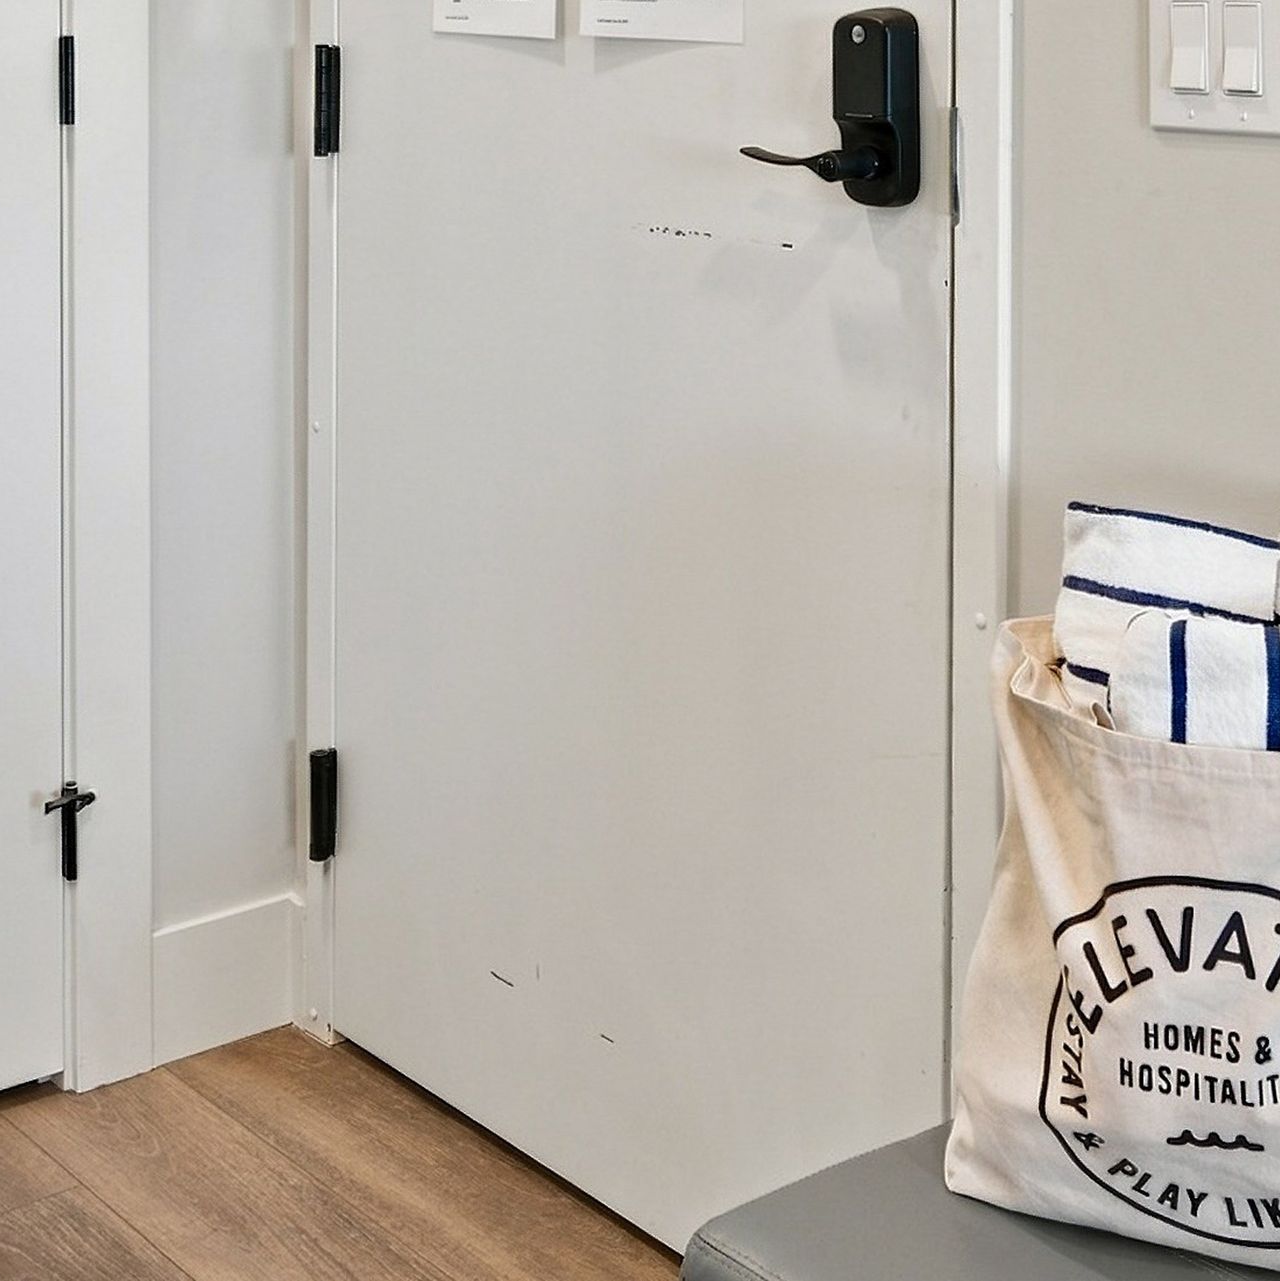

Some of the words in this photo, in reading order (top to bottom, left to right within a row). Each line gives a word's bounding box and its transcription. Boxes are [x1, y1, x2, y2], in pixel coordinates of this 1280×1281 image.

[1143, 1021, 1241, 1064] HOMES
[1254, 1035, 1272, 1065] &
[1060, 1013, 1088, 1120] STAY
[1107, 1157, 1209, 1218] PLAY
